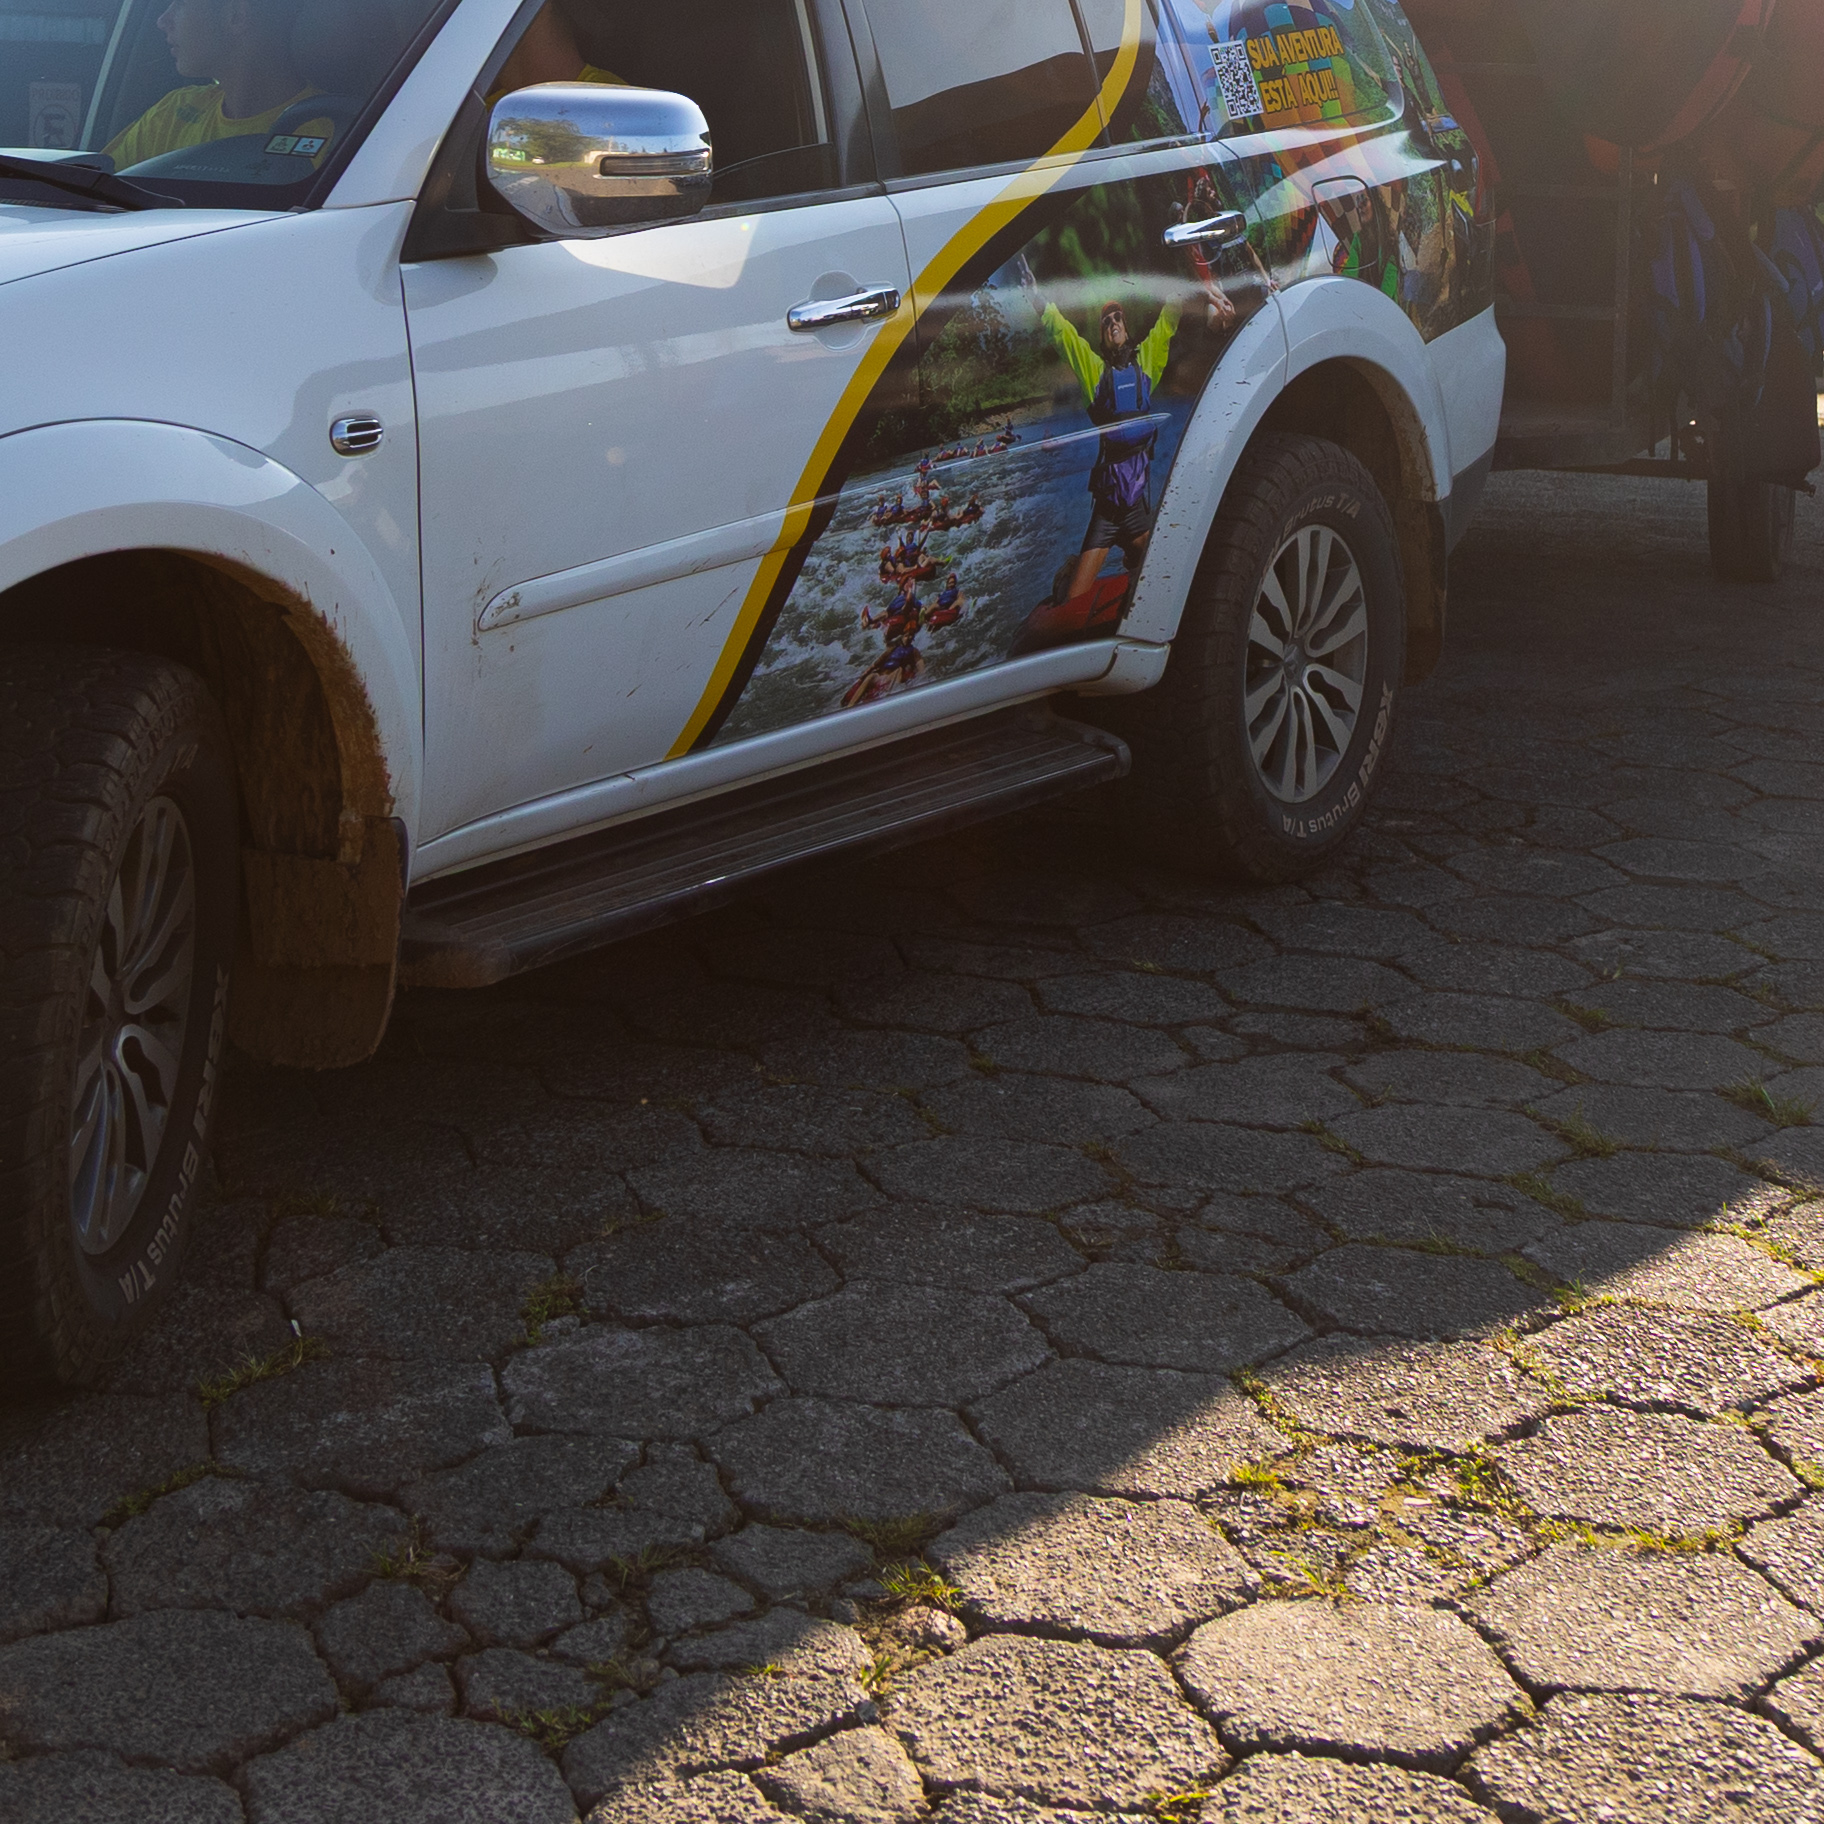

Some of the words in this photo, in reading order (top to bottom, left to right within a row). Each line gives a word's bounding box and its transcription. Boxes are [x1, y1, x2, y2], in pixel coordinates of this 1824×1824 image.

[1246, 36, 1280, 70] SUA
[1276, 25, 1345, 66] AVENTURA
[1259, 68, 1299, 114] ESTÁ
[1308, 781, 1362, 833] Brutus
